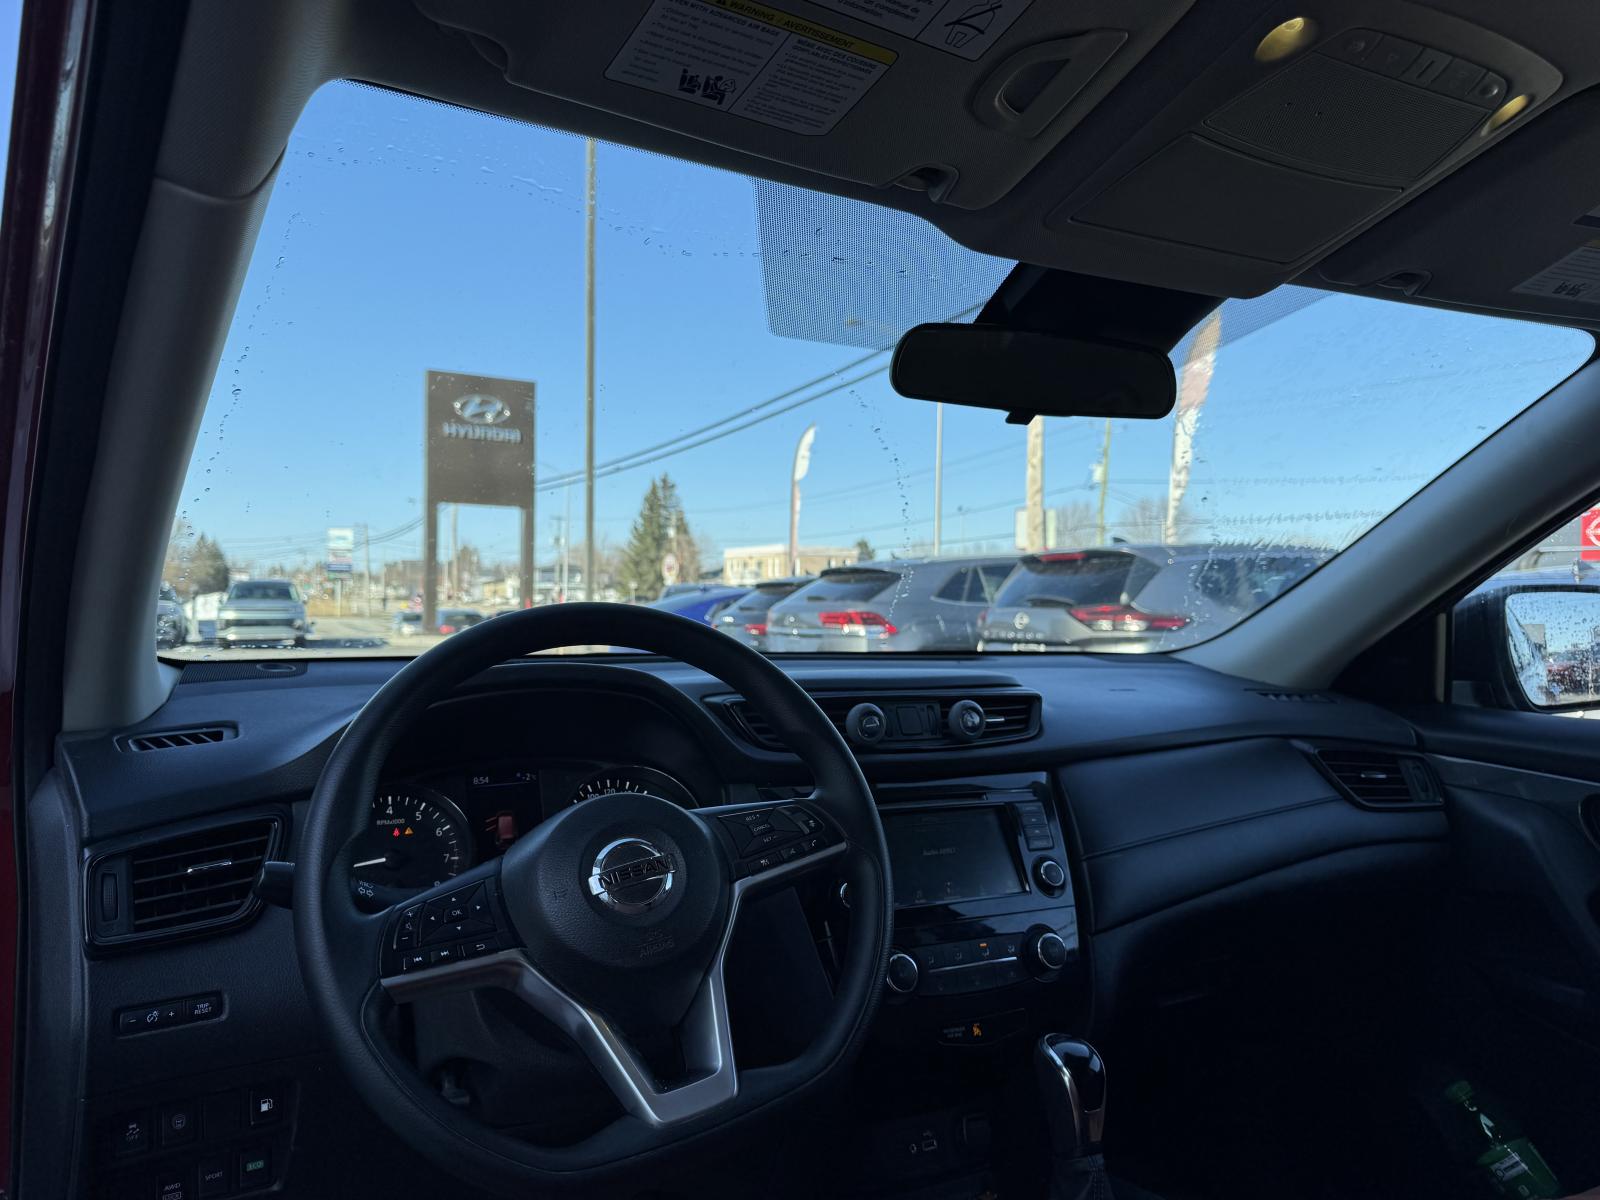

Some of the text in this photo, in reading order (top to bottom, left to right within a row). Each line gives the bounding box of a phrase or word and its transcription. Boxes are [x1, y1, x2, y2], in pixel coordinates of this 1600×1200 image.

[730, 0, 776, 21] WARNING
[783, 21, 855, 47] AVERTISSEMENT
[442, 422, 522, 444] HYUNDAI
[386, 806, 393, 815] 4
[415, 811, 422, 821] 5
[435, 827, 443, 837] 6
[443, 853, 449, 864] 7
[599, 858, 669, 886] NISSAN
[451, 909, 463, 917] OK
[163, 1182, 181, 1191] AWD
